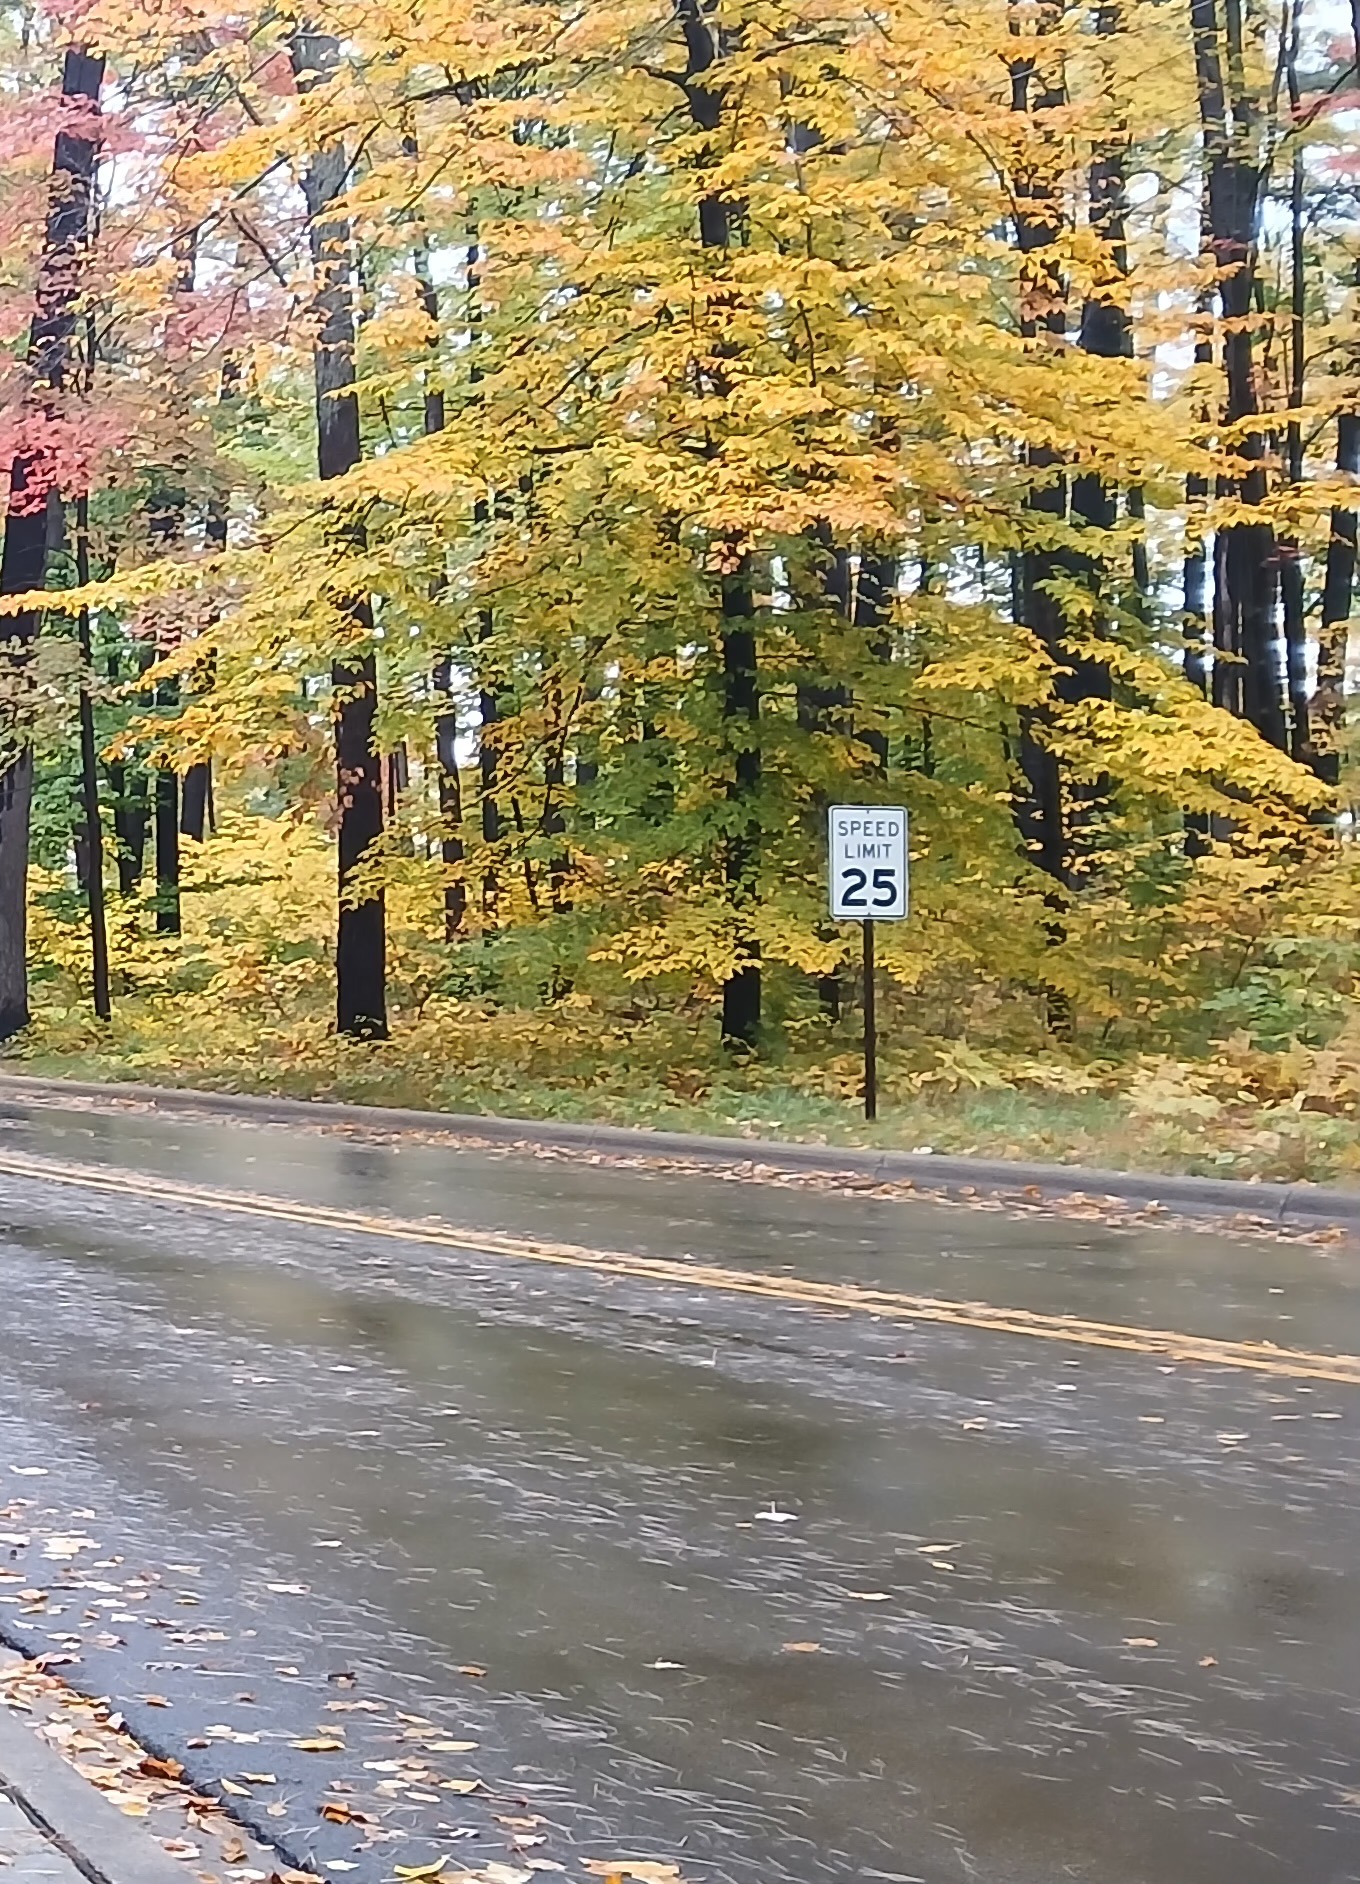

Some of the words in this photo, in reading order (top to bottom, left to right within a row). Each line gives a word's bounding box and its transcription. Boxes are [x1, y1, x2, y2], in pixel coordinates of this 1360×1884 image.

[837, 820, 900, 837] SPEED
[844, 843, 893, 859] LIMIT
[841, 867, 898, 907] 25
